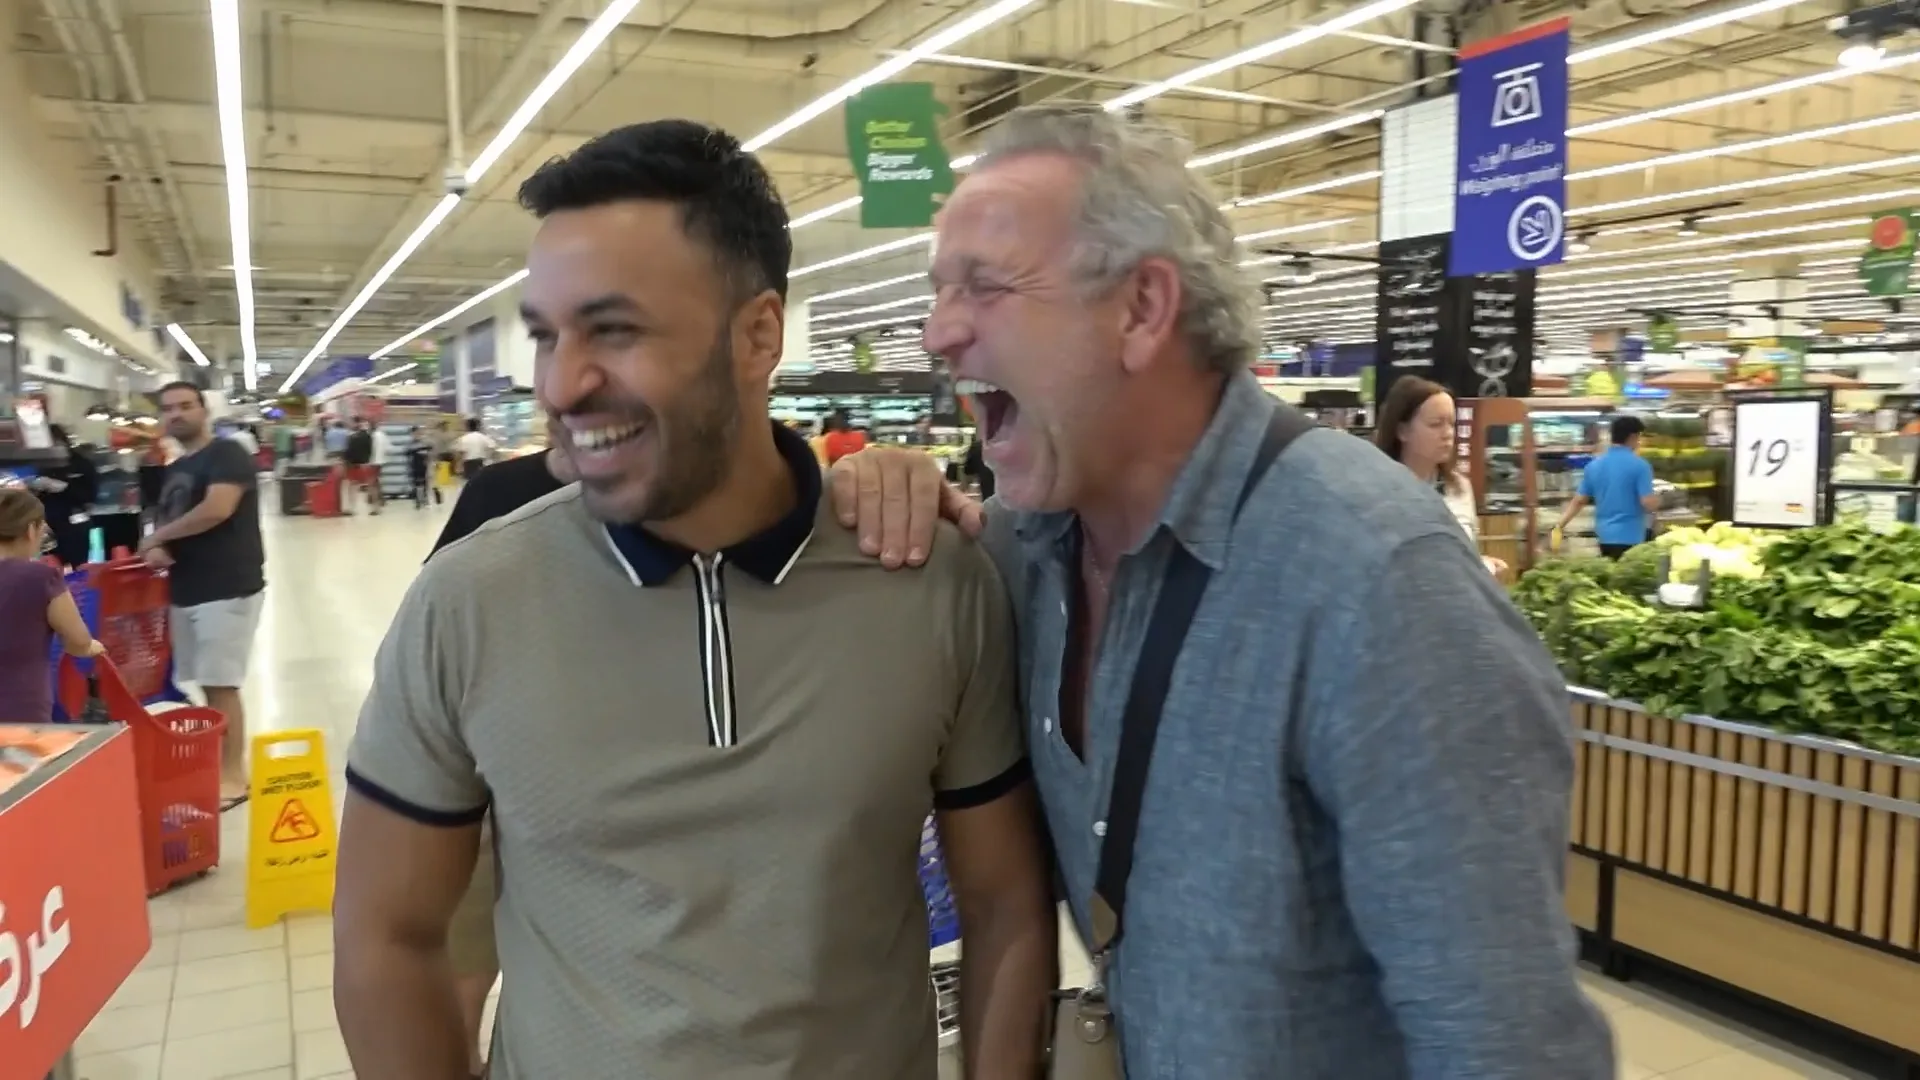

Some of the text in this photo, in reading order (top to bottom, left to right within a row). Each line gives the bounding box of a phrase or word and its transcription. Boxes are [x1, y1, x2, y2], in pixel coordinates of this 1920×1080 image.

[866, 151, 917, 169] Bigger
[868, 167, 934, 182] Rewards
[1749, 438, 1790, 477] 19
